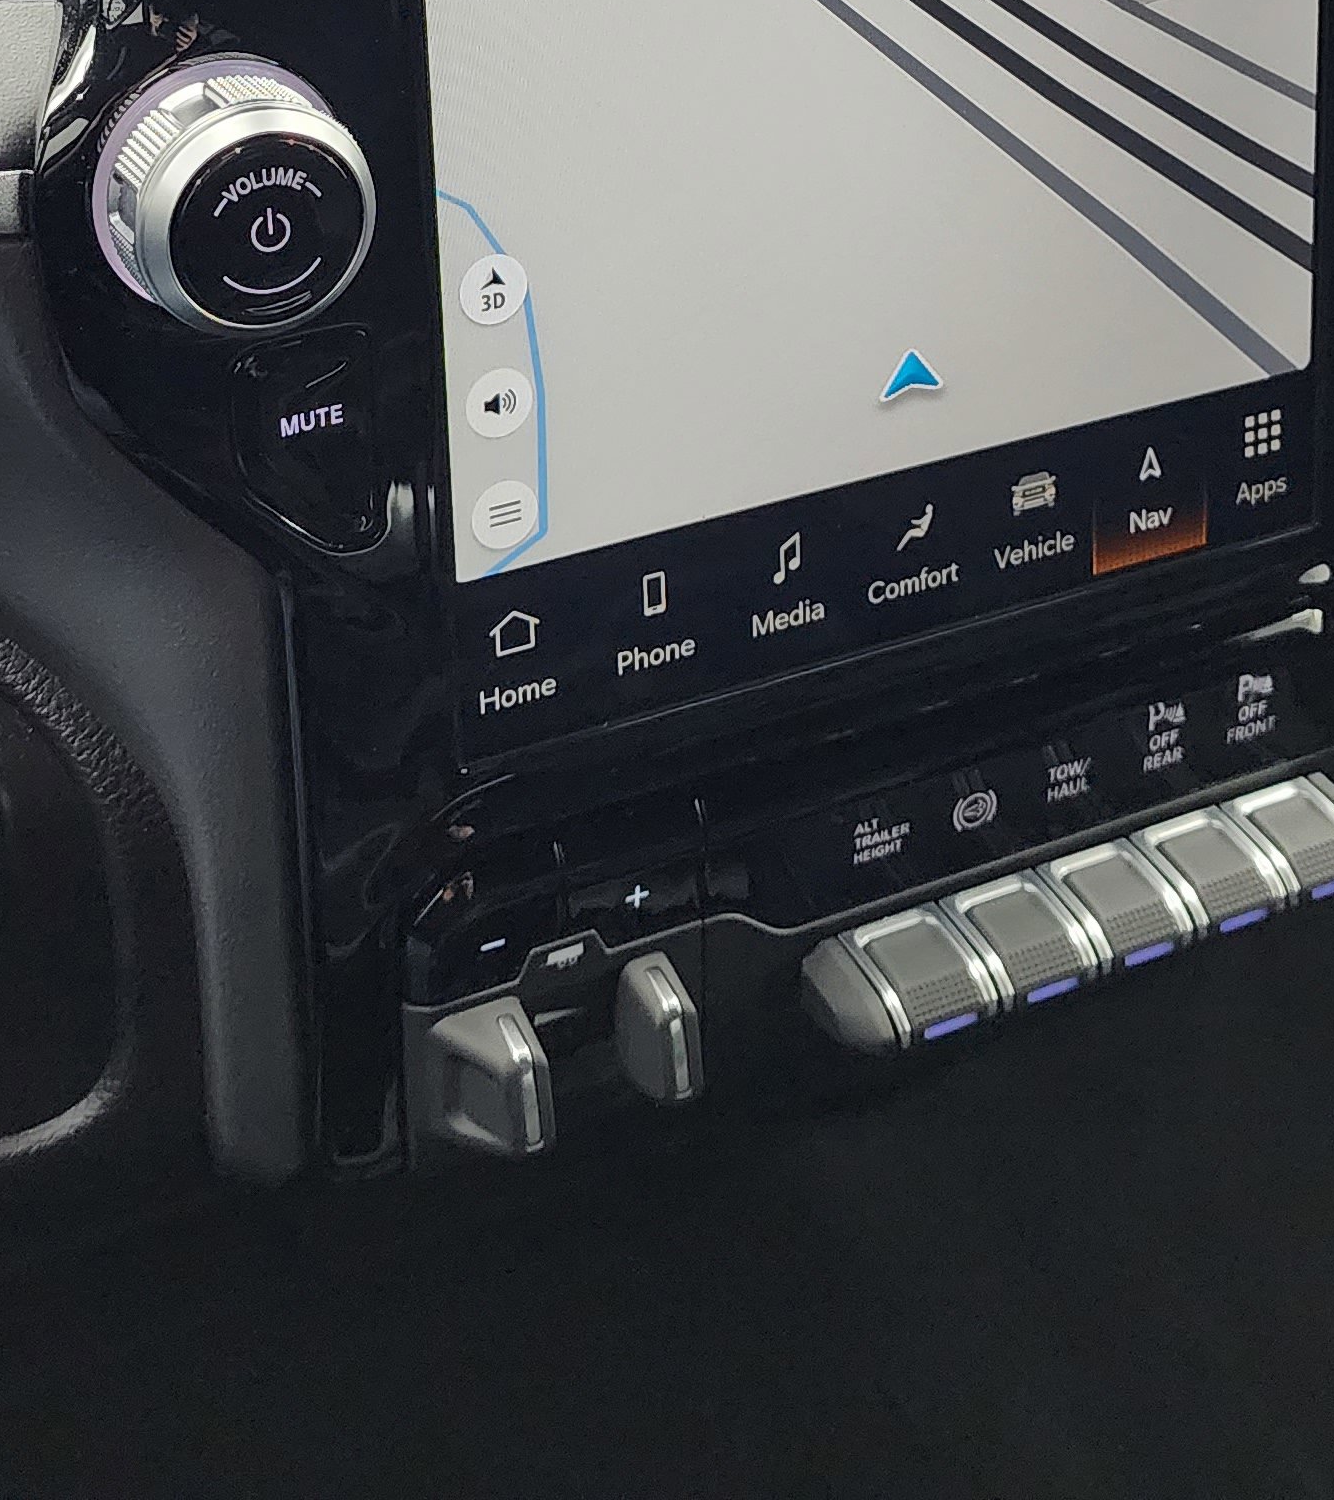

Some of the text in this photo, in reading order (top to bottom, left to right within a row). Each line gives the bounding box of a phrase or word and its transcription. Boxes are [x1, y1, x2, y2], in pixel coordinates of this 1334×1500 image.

[222, 167, 307, 203] VOLUME
[481, 292, 505, 312] 3D
[279, 404, 344, 438] MUTE
[1235, 472, 1288, 509] Apps
[1128, 503, 1172, 536] Nav
[994, 531, 1075, 572] Vehicle
[867, 561, 960, 607] Comfort
[751, 598, 826, 640] Media
[616, 635, 696, 677] Phone
[479, 672, 557, 715] Home
[1237, 701, 1268, 723] OFF
[1149, 728, 1180, 751] OFF
[1226, 715, 1277, 745] FRONT
[1142, 746, 1185, 773] REAR
[1047, 778, 1089, 802] HAUL
[853, 818, 879, 837] ALT
[854, 821, 911, 850] TRAILER
[853, 840, 902, 865] HEIGHT
